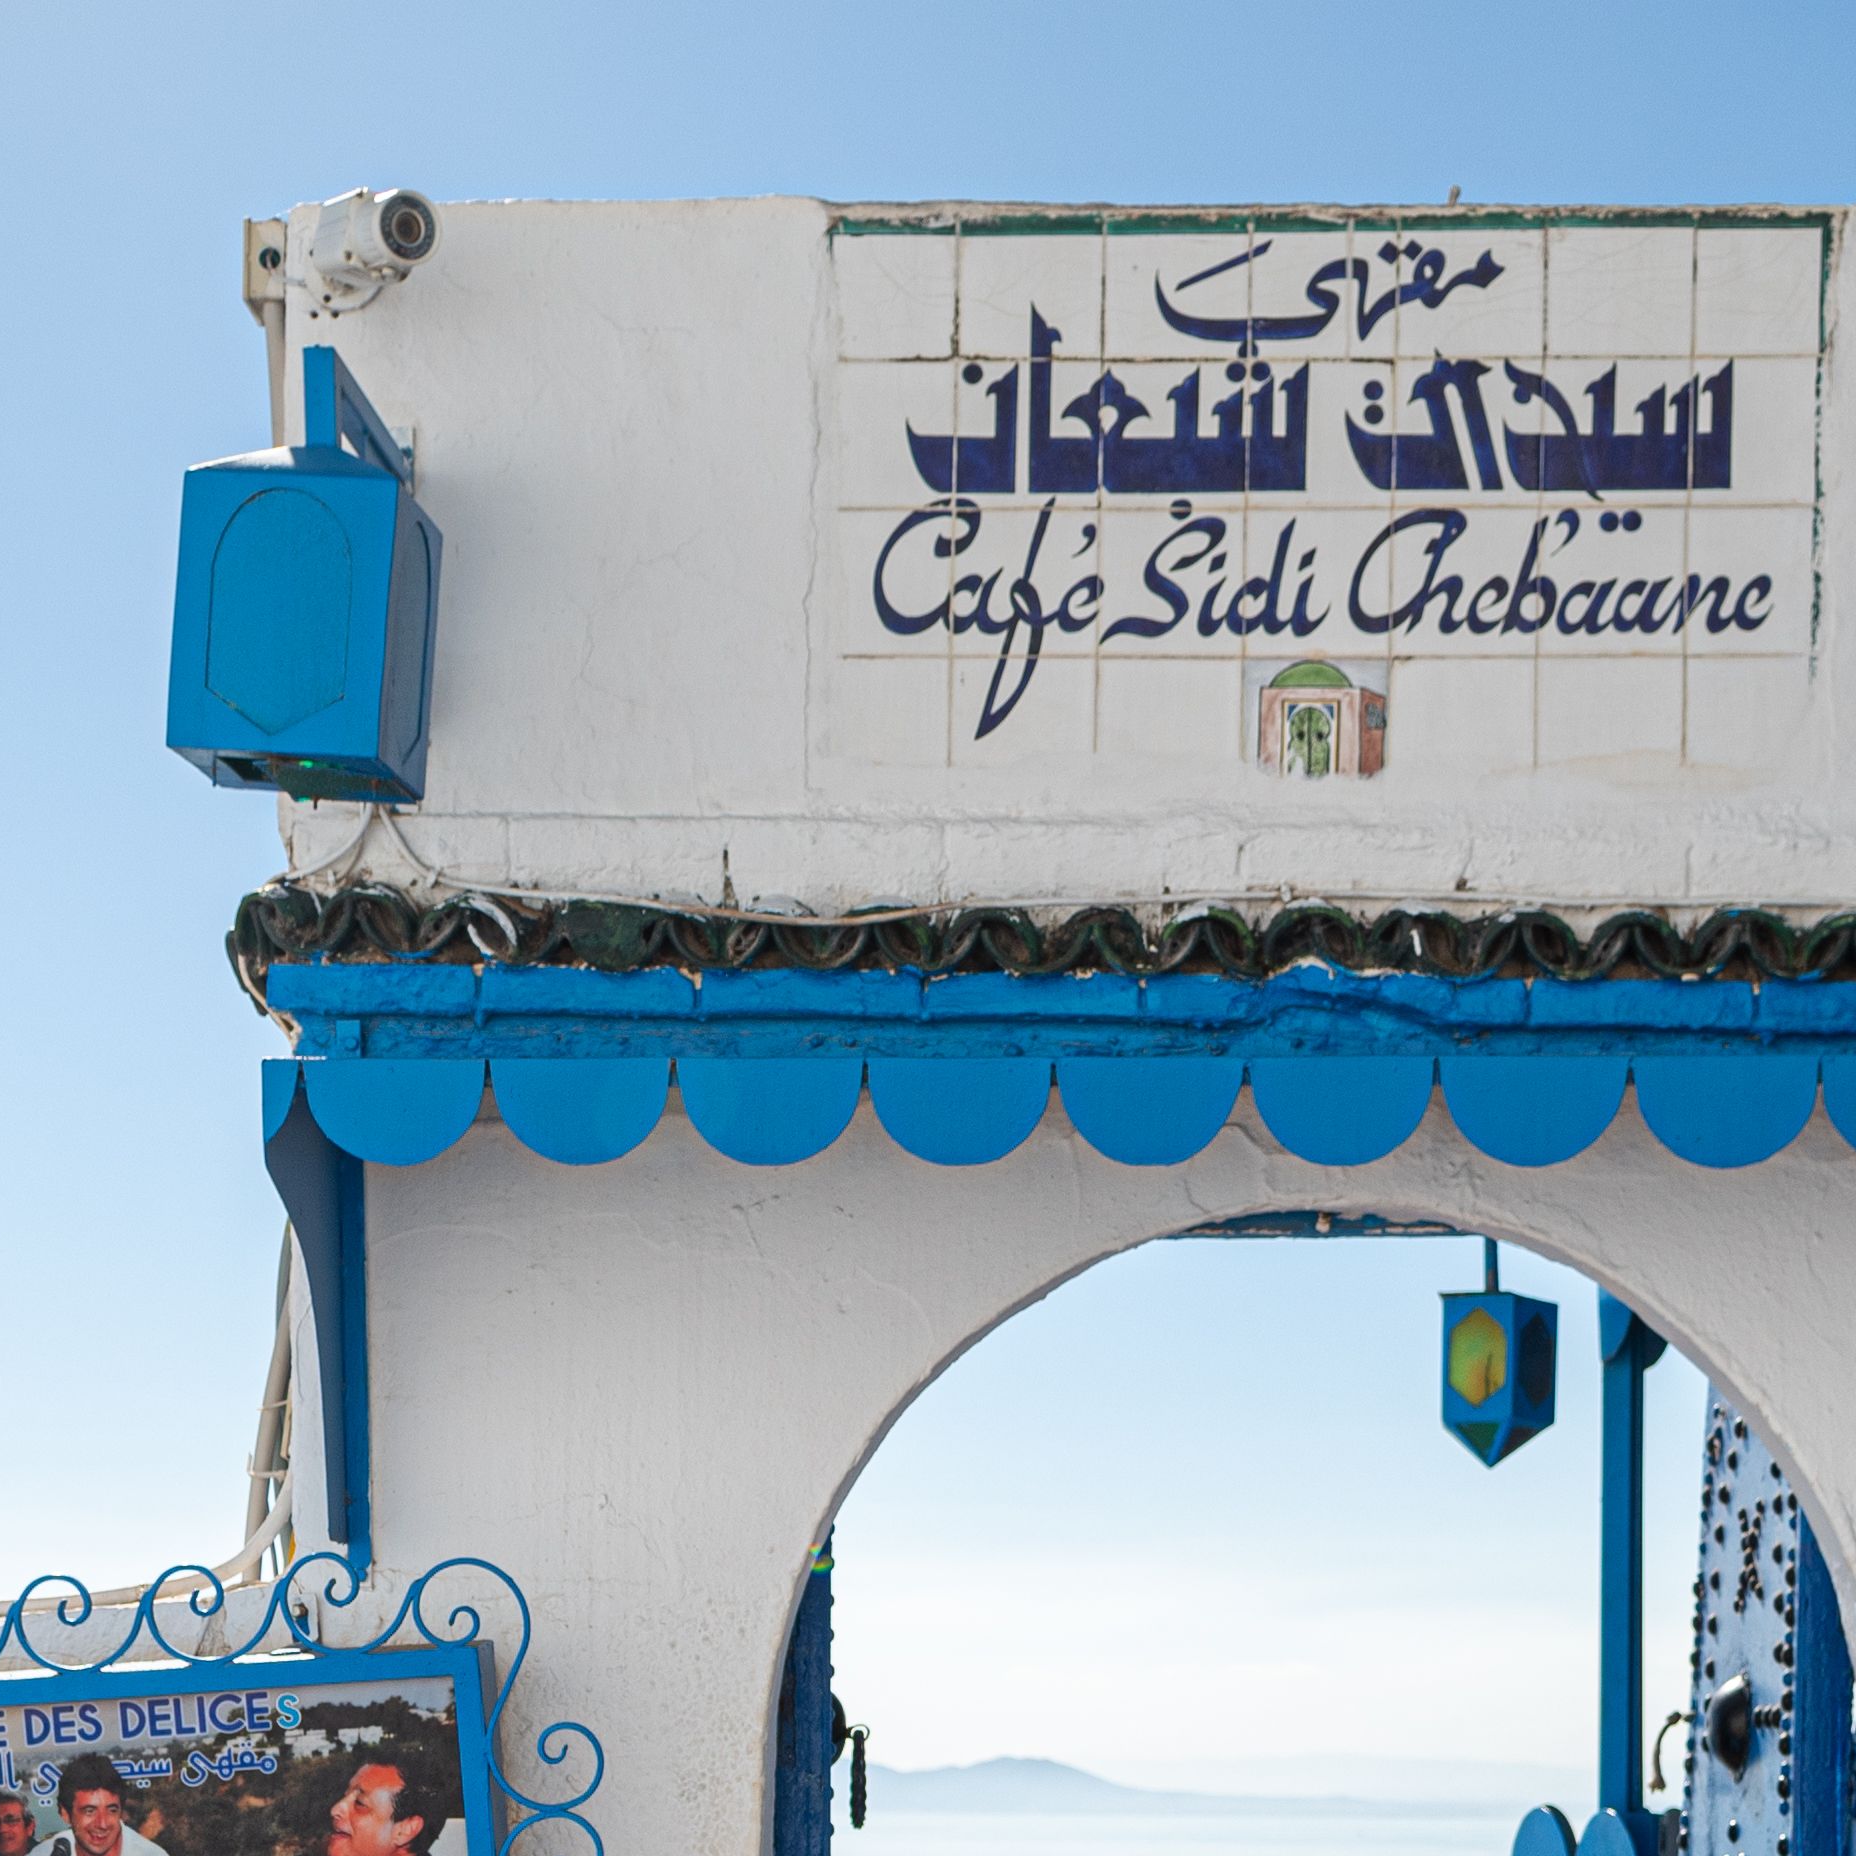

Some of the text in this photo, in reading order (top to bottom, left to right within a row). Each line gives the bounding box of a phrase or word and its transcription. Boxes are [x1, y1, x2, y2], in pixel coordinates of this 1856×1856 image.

[1156, 240, 1505, 341] مقهى
[1346, 348, 1733, 531] سيدي
[873, 496, 1105, 740] Café
[1099, 515, 1331, 645] Sidi
[23, 1703, 104, 1747] DES
[118, 1690, 303, 1741] DELICES
[180, 1739, 278, 1787] مقهى
